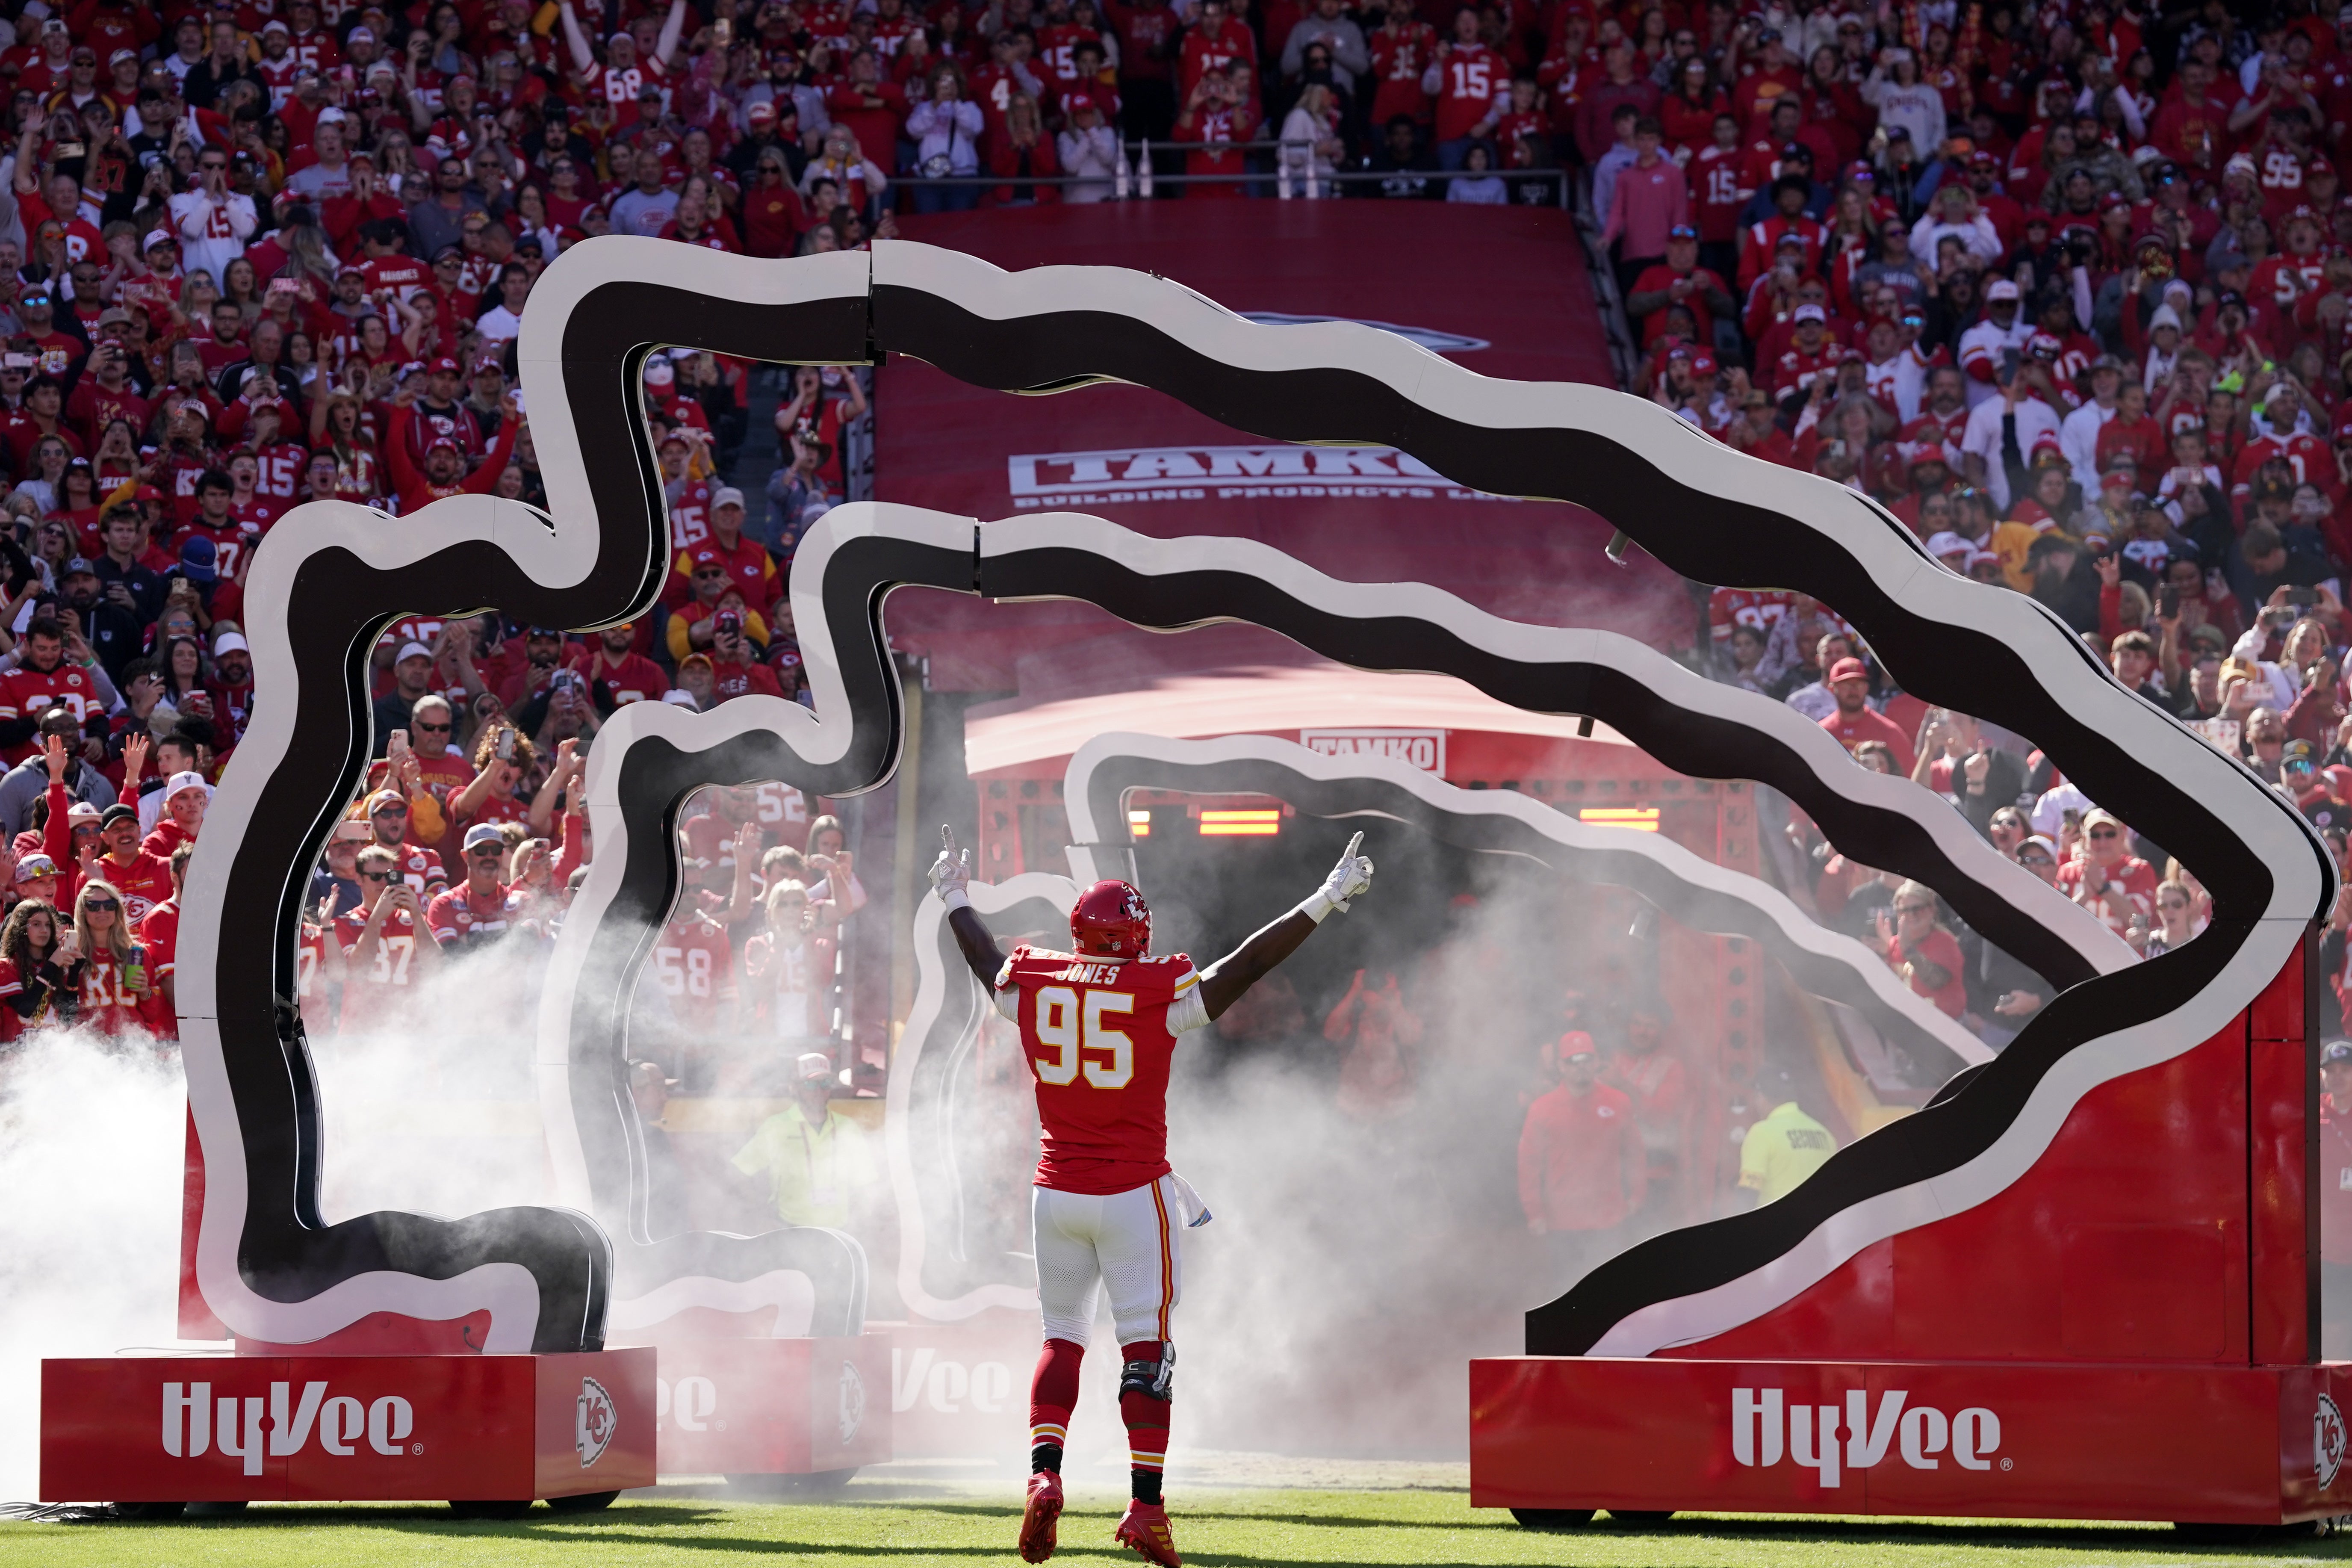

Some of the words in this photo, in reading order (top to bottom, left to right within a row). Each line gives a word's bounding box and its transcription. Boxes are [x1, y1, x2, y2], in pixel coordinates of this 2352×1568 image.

[604, 69, 641, 102] 68
[991, 78, 1010, 111] 4
[1452, 62, 1490, 99] 15
[1707, 169, 1736, 204] 15
[2261, 151, 2302, 189] 95
[208, 206, 232, 239] 15
[255, 455, 294, 497] 15
[1014, 487, 1205, 508] BUILDING
[1218, 484, 1435, 499] PRODUCTS
[1447, 489, 1523, 502] LL
[671, 506, 708, 549] 15
[1310, 737, 1435, 770] TAMKO
[757, 783, 807, 824] 52
[657, 947, 711, 998] 58
[1055, 963, 1120, 985] JONES
[1035, 985, 1135, 1090] 95
[892, 1347, 1011, 1414] Vee
[162, 1381, 413, 1476] HyVee
[1732, 1388, 2001, 1488] HyVee
